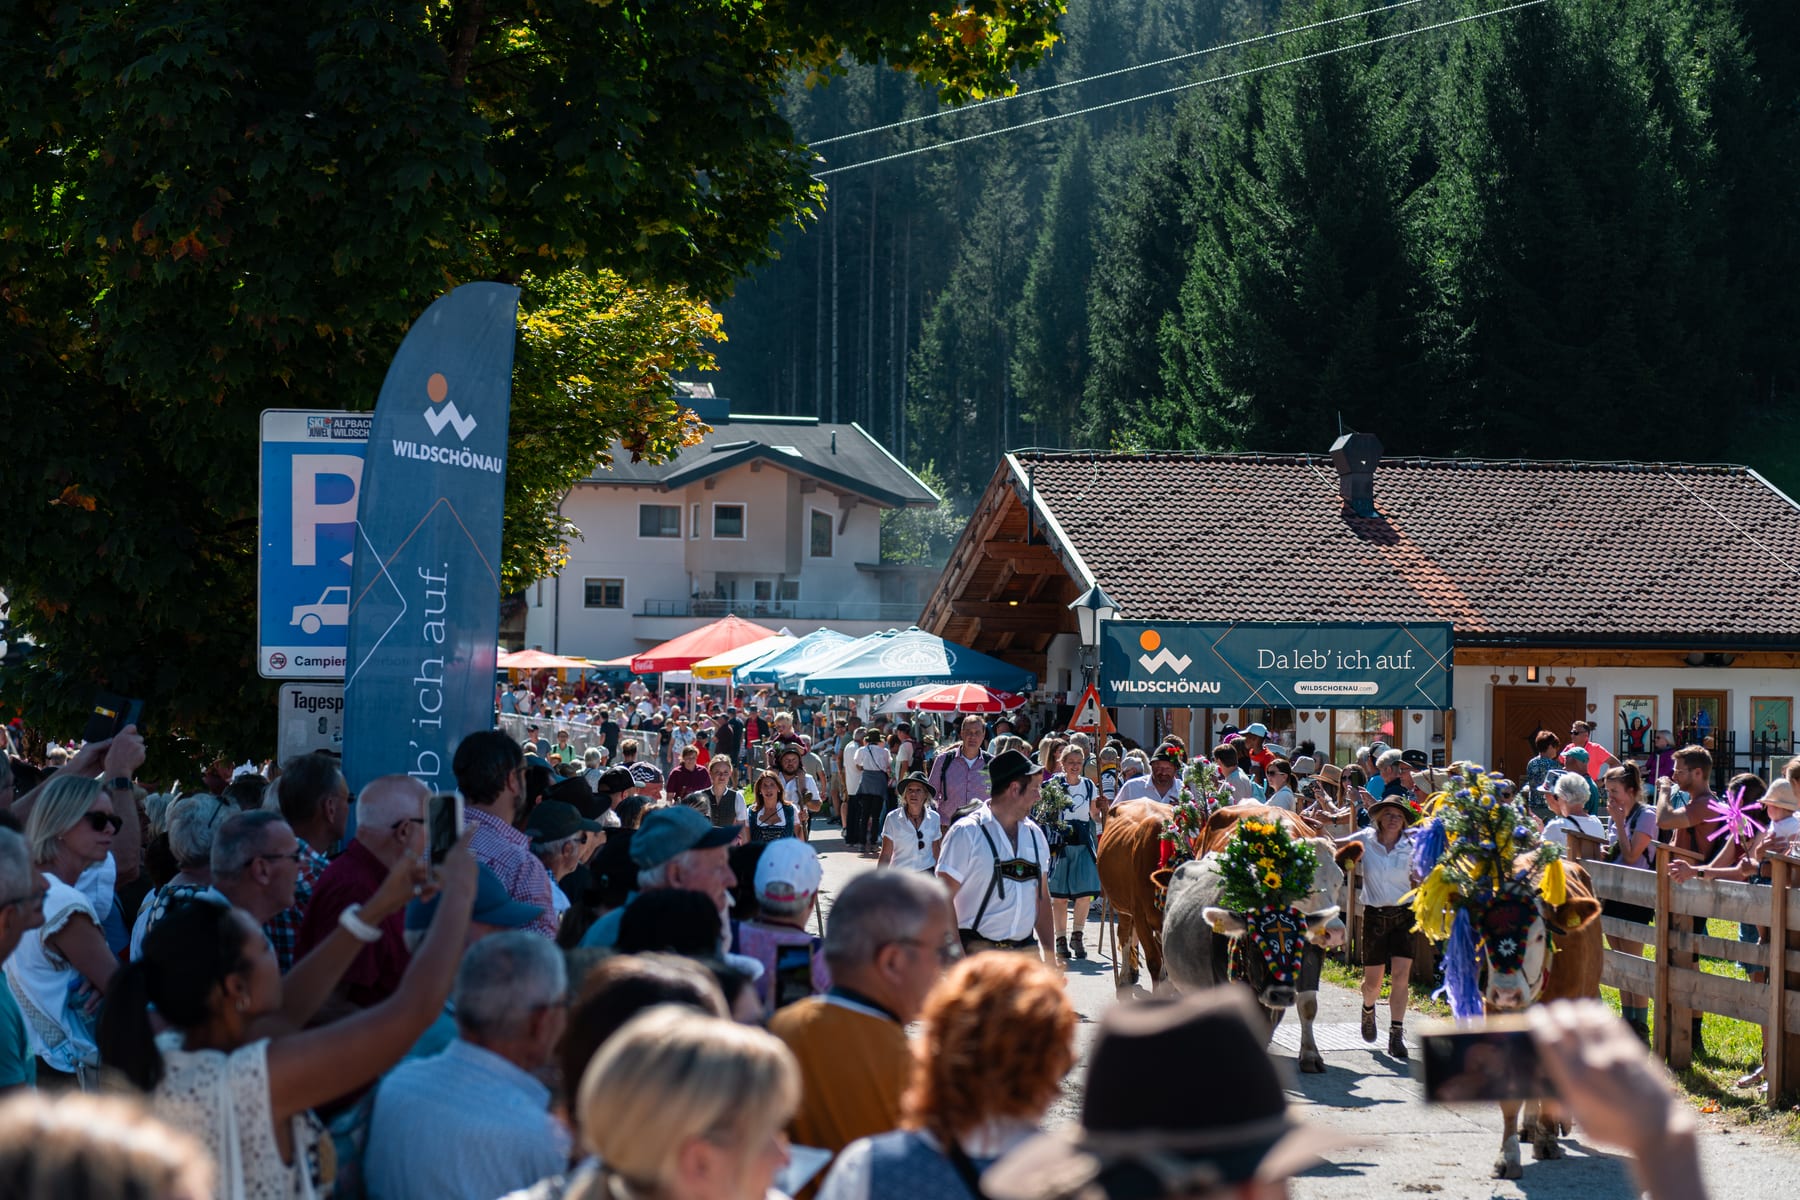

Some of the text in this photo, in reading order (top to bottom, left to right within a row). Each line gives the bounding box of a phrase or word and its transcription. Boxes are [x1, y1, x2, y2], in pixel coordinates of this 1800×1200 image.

[308, 417, 324, 427] SKI
[392, 439, 502, 474] WILDSCHÖNAU
[292, 454, 365, 566] P
[418, 562, 448, 644] auf.
[294, 655, 347, 668] Campier
[1257, 649, 1289, 669] Da
[1336, 650, 1372, 669] ich
[1376, 650, 1415, 670] auf.
[411, 656, 444, 728] ich
[1110, 678, 1221, 694] WILDSCHÖNAU
[291, 691, 344, 714] Tagesp
